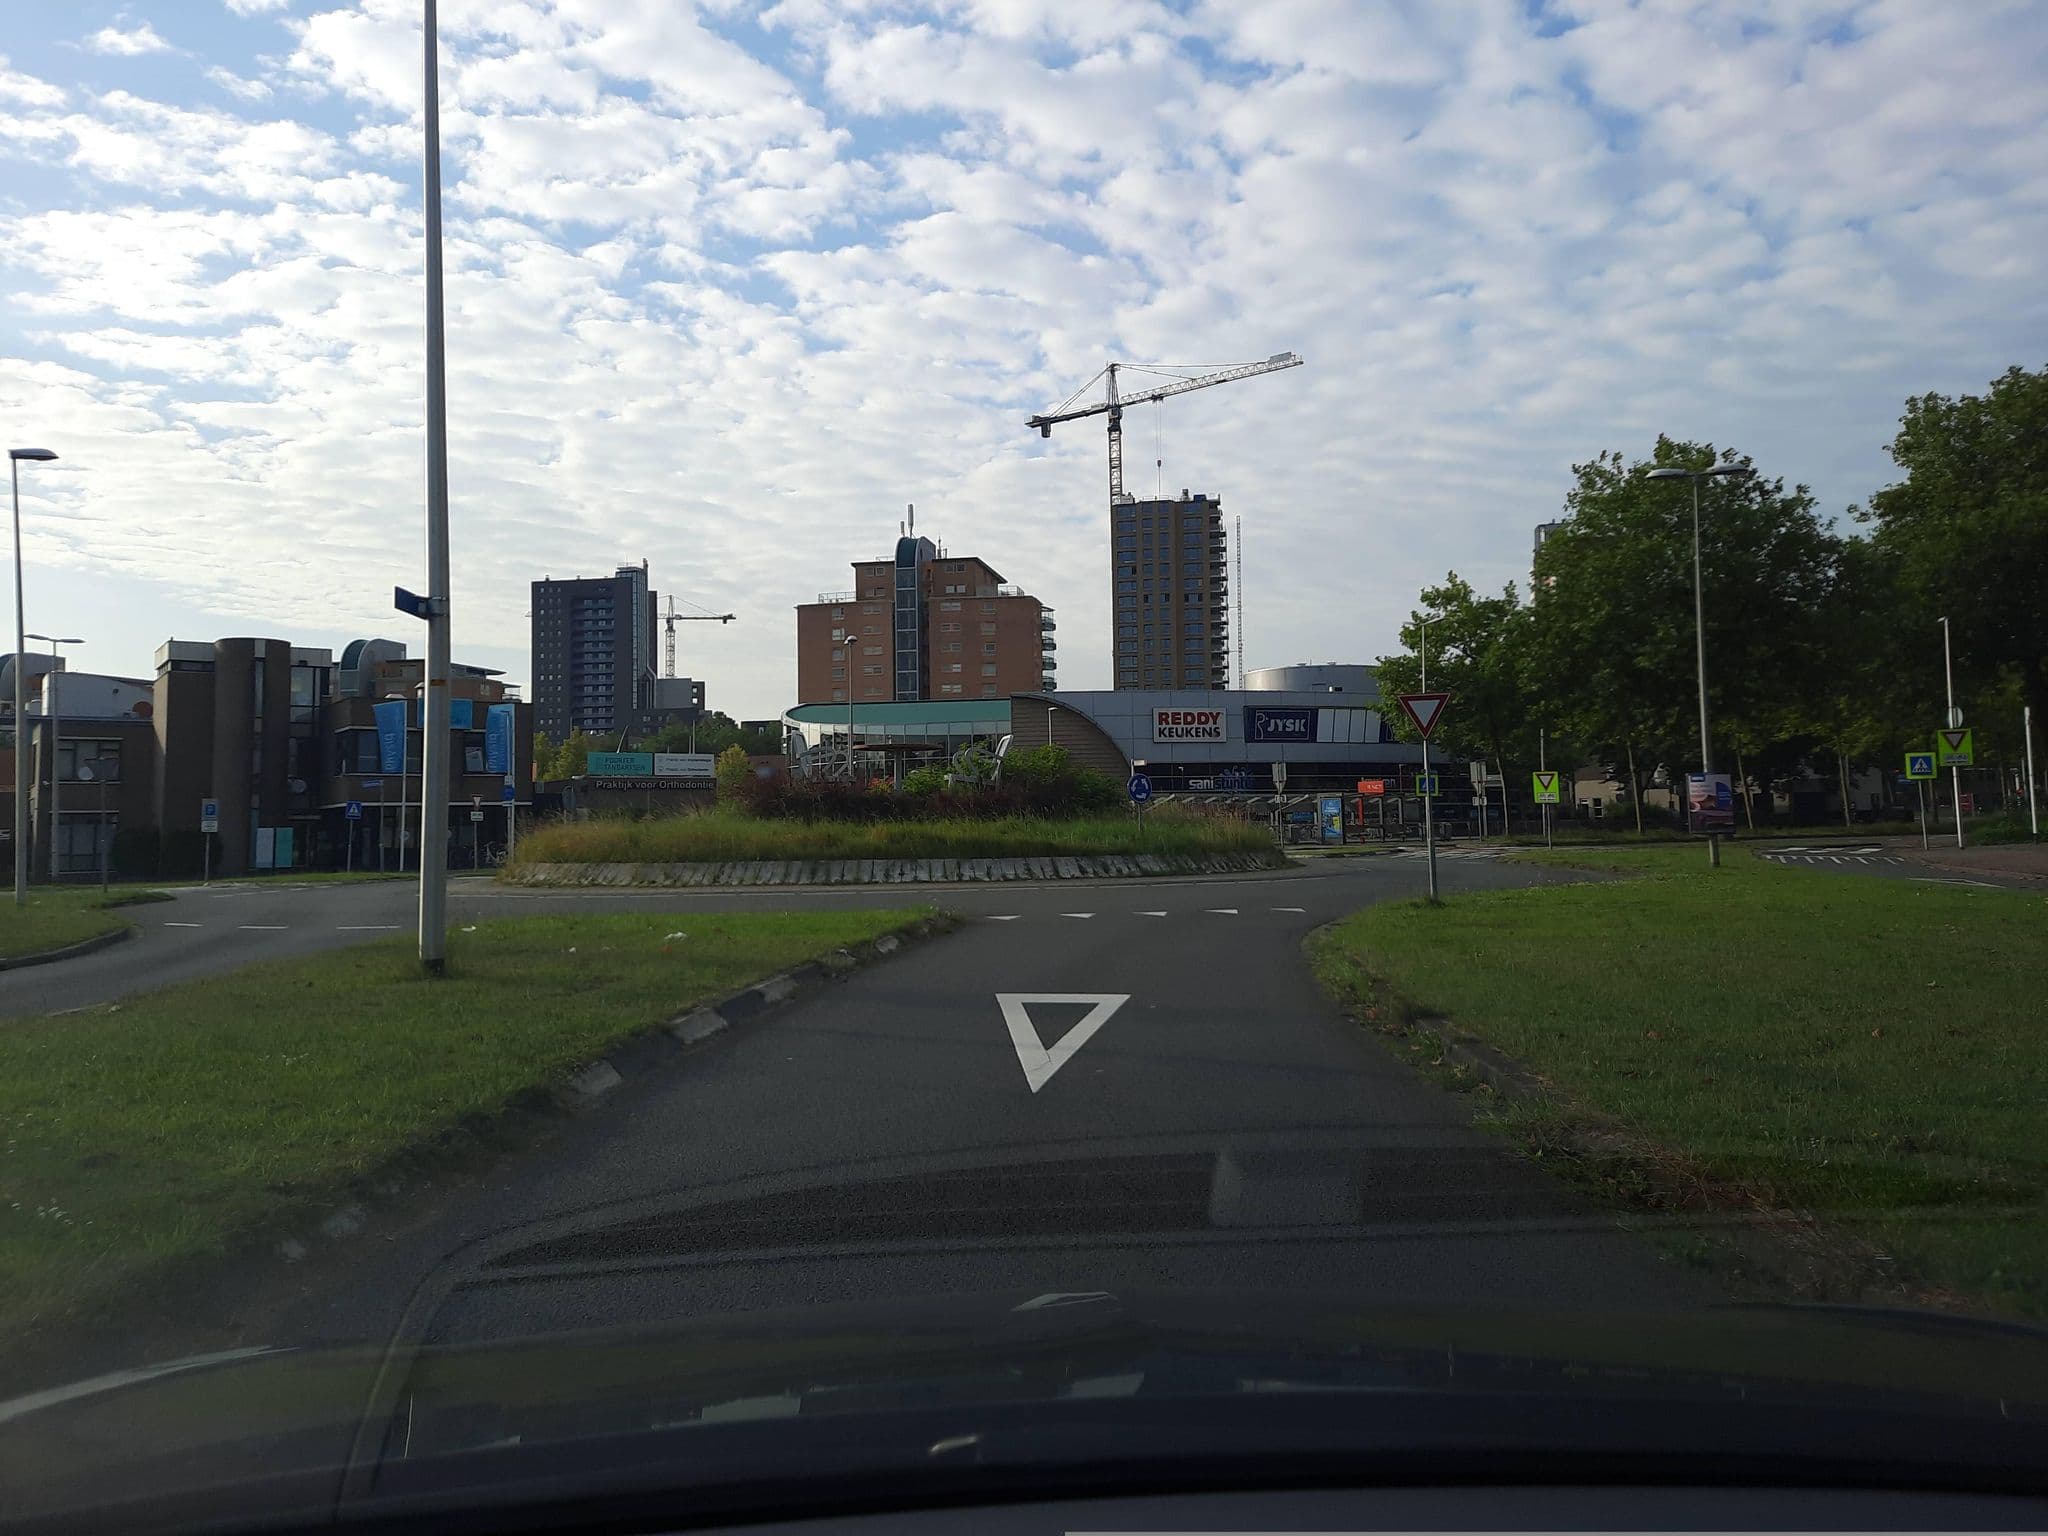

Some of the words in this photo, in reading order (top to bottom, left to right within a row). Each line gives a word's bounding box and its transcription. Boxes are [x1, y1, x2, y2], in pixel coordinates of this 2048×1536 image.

[1158, 711, 1221, 725] REDDY
[1267, 718, 1306, 732] JYSK
[1158, 726, 1221, 738] KEUKENS
[596, 780, 633, 790] Praktijk
[659, 780, 714, 789] Orthodontie
